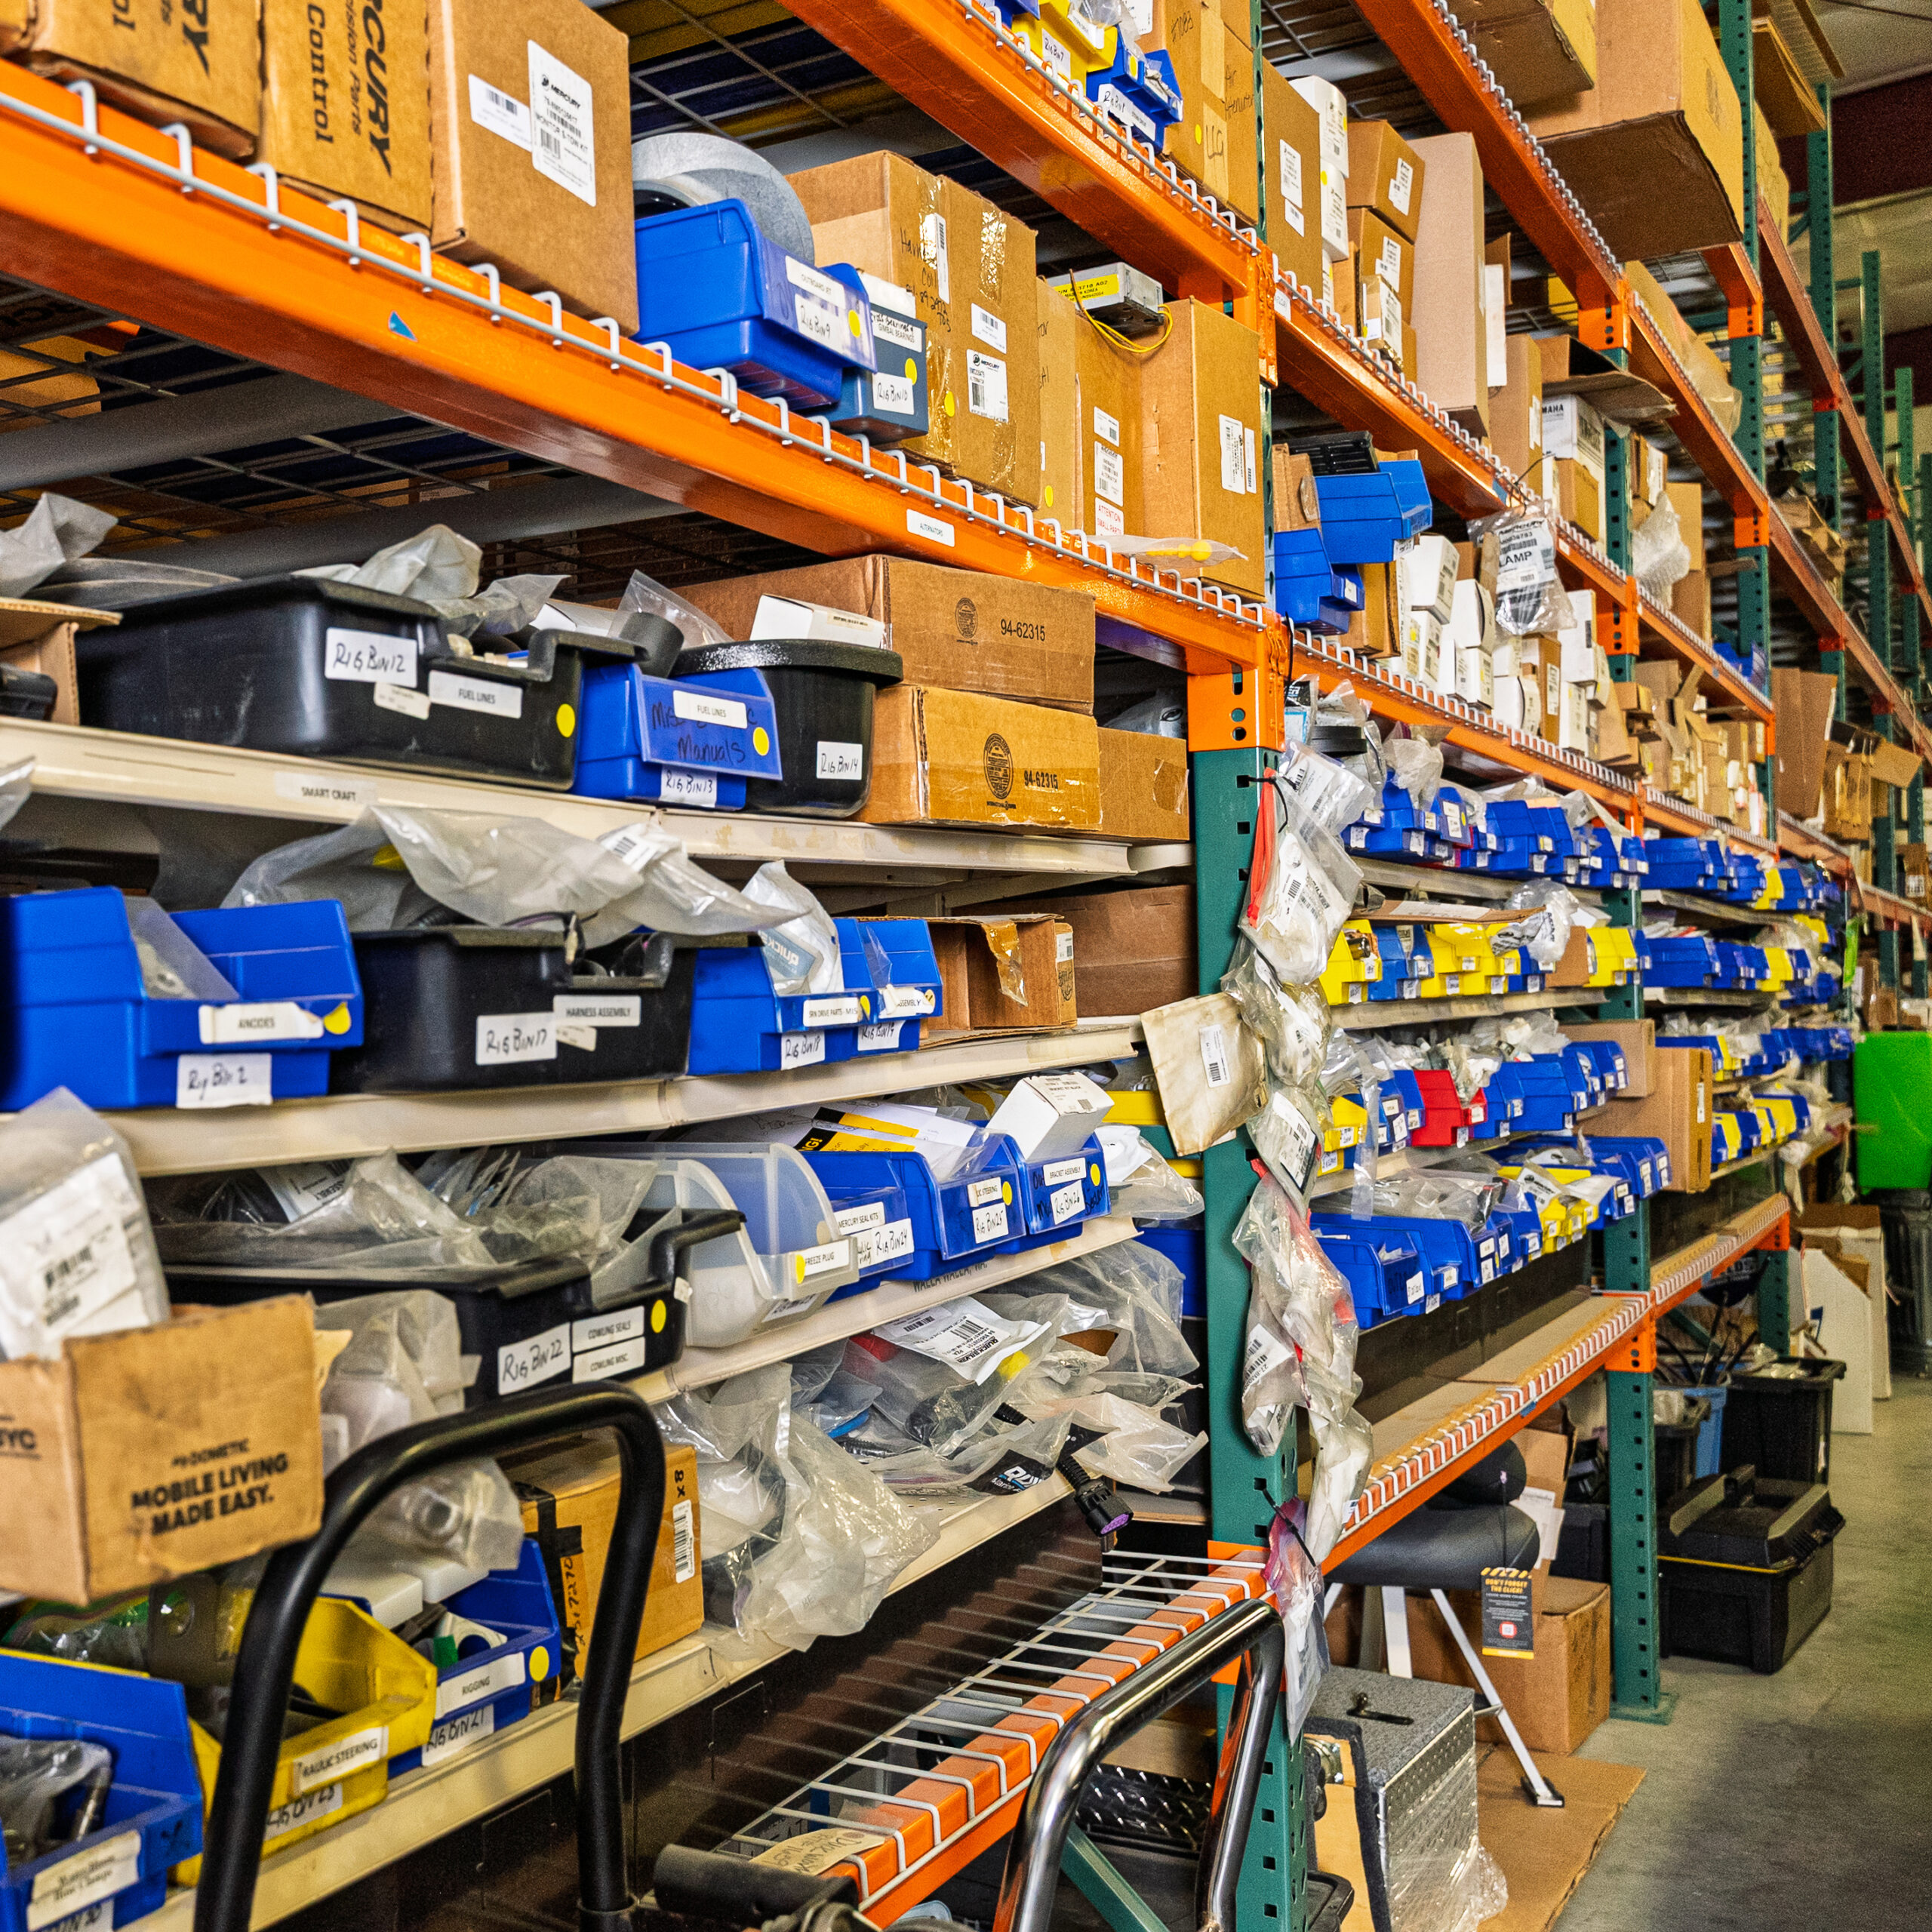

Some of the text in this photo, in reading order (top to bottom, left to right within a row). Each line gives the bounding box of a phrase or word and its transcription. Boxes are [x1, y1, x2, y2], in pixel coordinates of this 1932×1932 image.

[307, 3, 334, 143] Control
[1542, 403, 1564, 414] MAHA
[1001, 619, 1046, 641] 94-62315
[333, 642, 363, 672] RIG
[459, 688, 496, 705] FUEL LINES
[697, 705, 727, 718] FUEL LINES
[1023, 770, 1059, 789] 94-62315
[301, 786, 329, 798] SMART
[566, 1008, 631, 1017] HARNESS ASSEMBLY
[1050, 1166, 1081, 1180] BRACKET ASSEMBLY
[838, 1211, 879, 1229] MERCURY SEAL KITS
[804, 1251, 835, 1266] FREEZE PLUG
[612, 1320, 632, 1333] SEALS
[131, 1452, 289, 1510] MOBILE LIVING
[151, 1483, 275, 1537] MADE EASY.
[462, 1676, 491, 1696] RIGGING
[334, 1737, 378, 1764] STEERING
